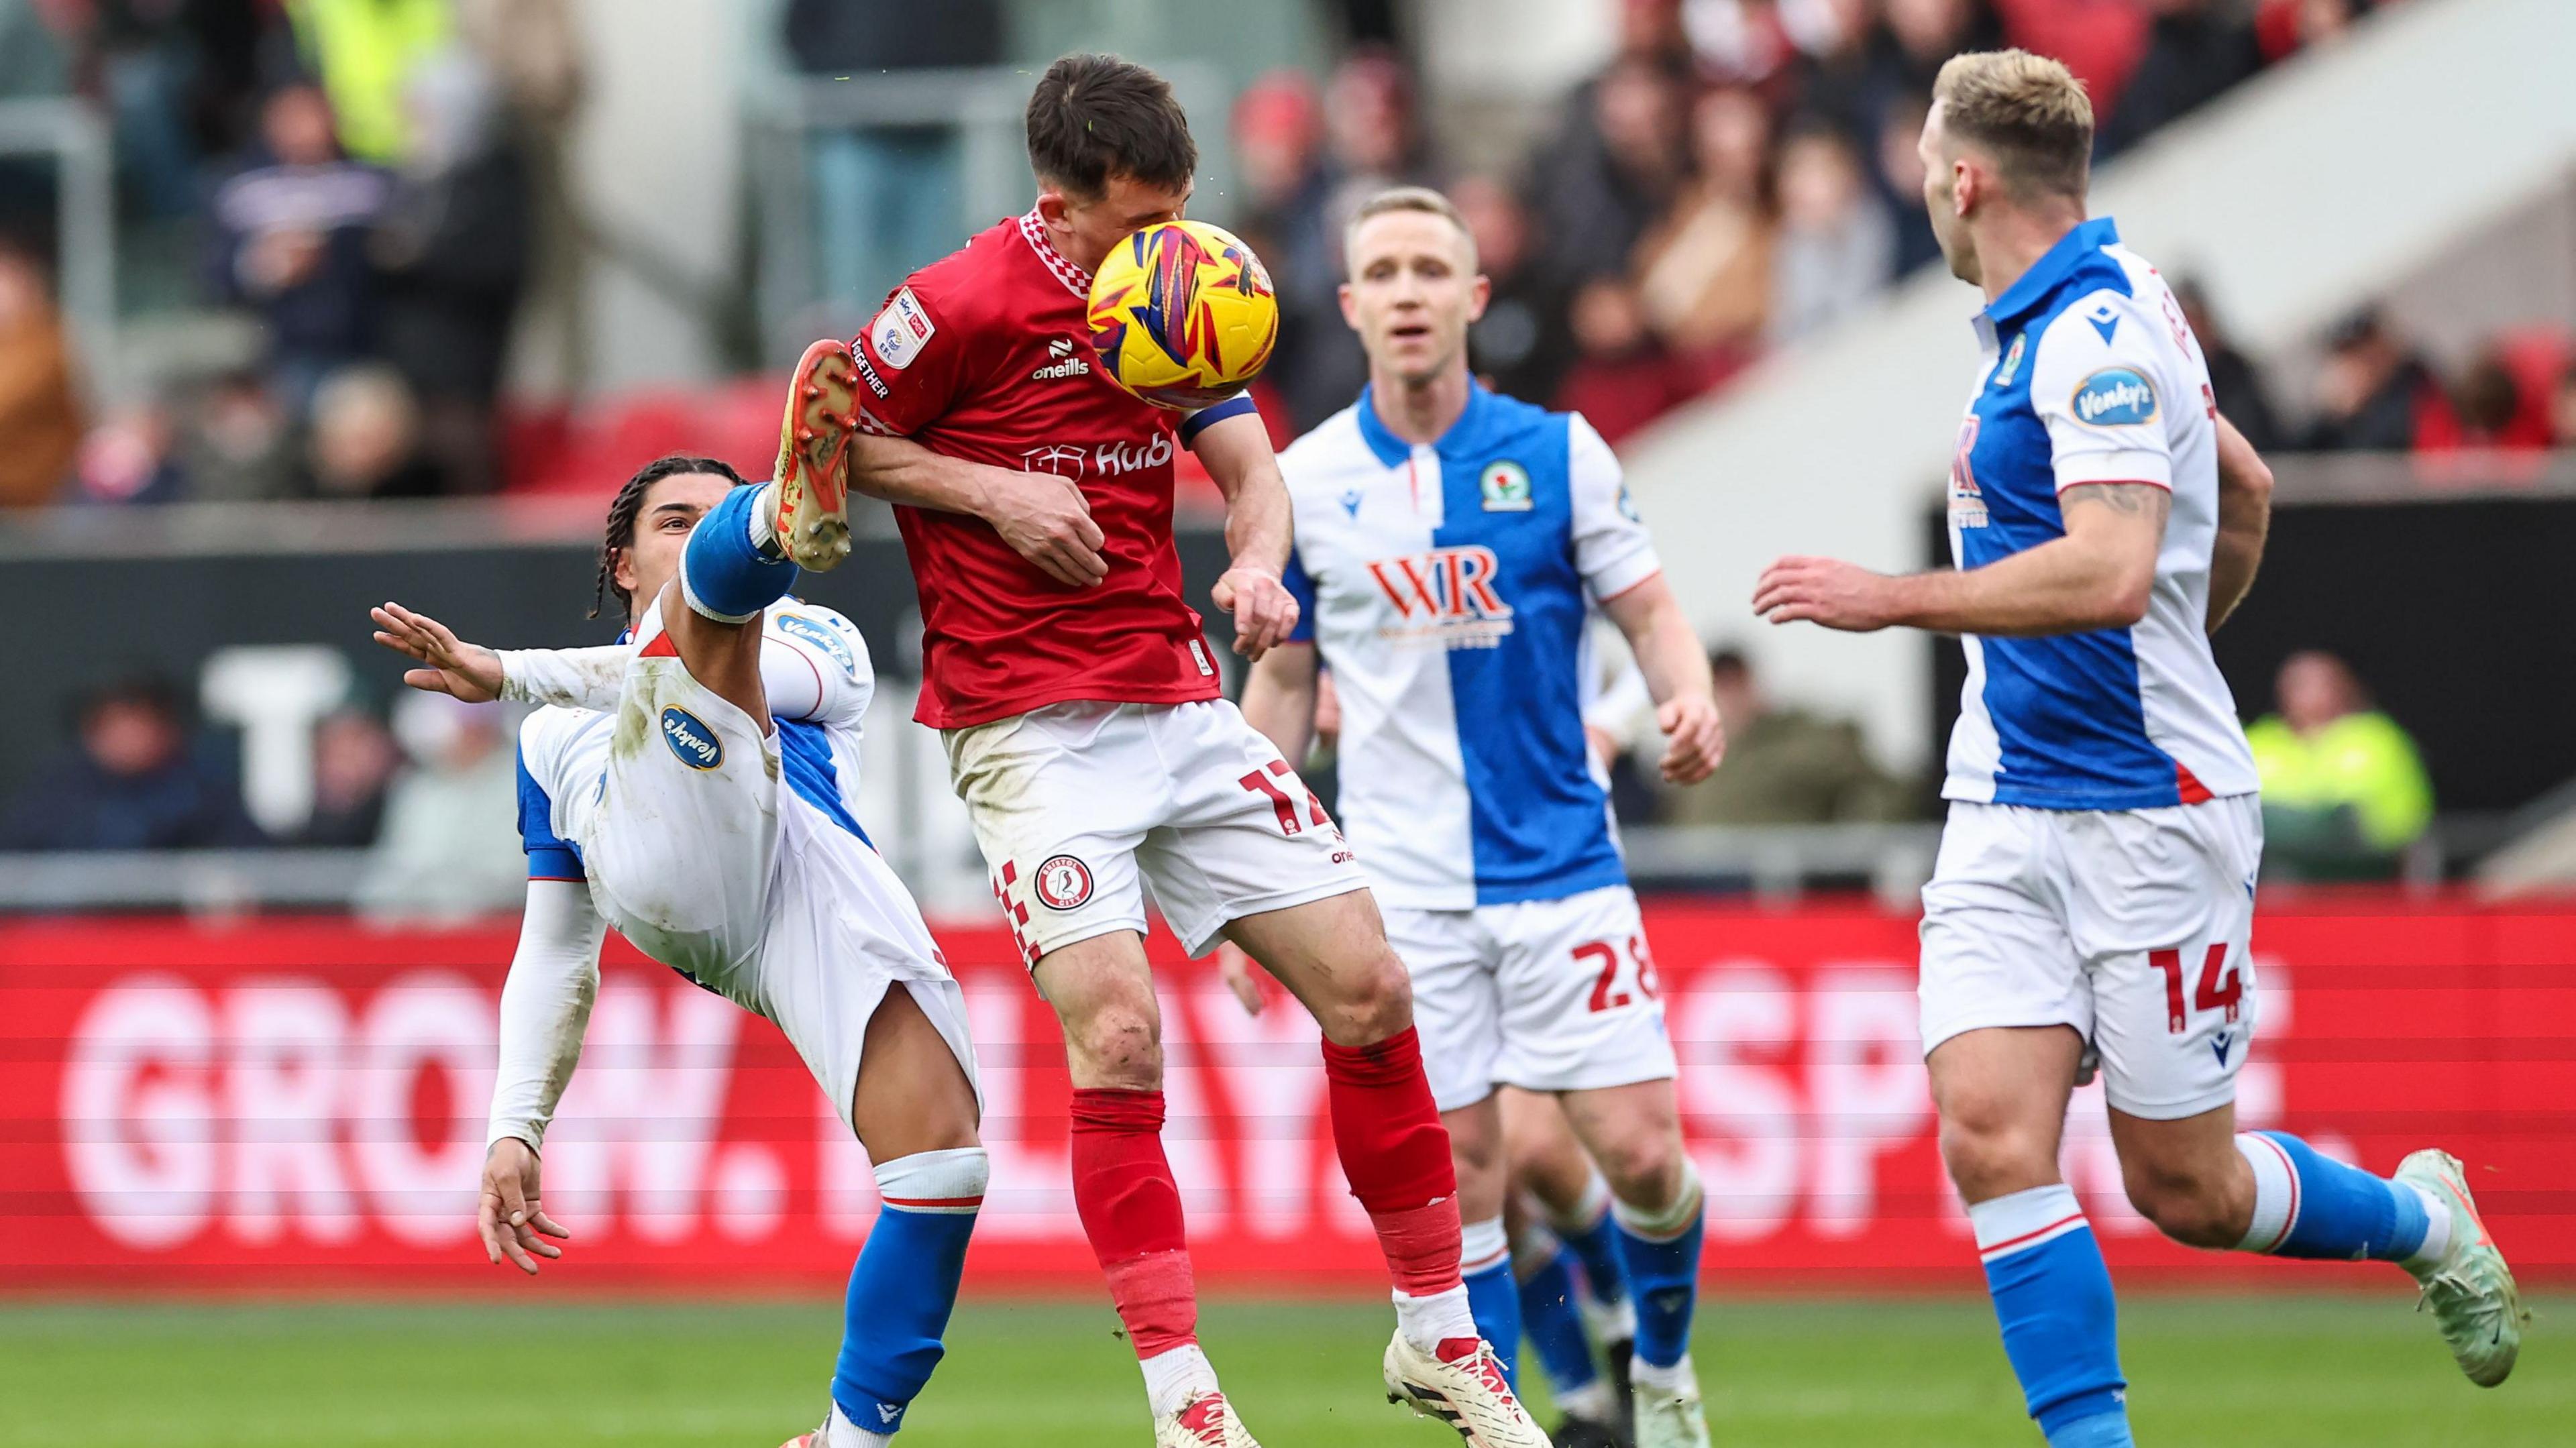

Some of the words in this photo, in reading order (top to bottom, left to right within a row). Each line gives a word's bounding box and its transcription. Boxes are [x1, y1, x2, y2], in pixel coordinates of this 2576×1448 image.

[899, 298, 912, 316] sky
[910, 315, 926, 339] bet
[879, 342, 893, 361] EFL
[1095, 432, 1173, 476] Hub
[1366, 546, 1513, 621] WR
[784, 620, 853, 669] Venky's
[663, 717, 718, 763] Venky's
[1042, 858, 1078, 875] BRISTOL
[1058, 895, 1081, 907] CITY
[2148, 942, 2242, 1034] 14
